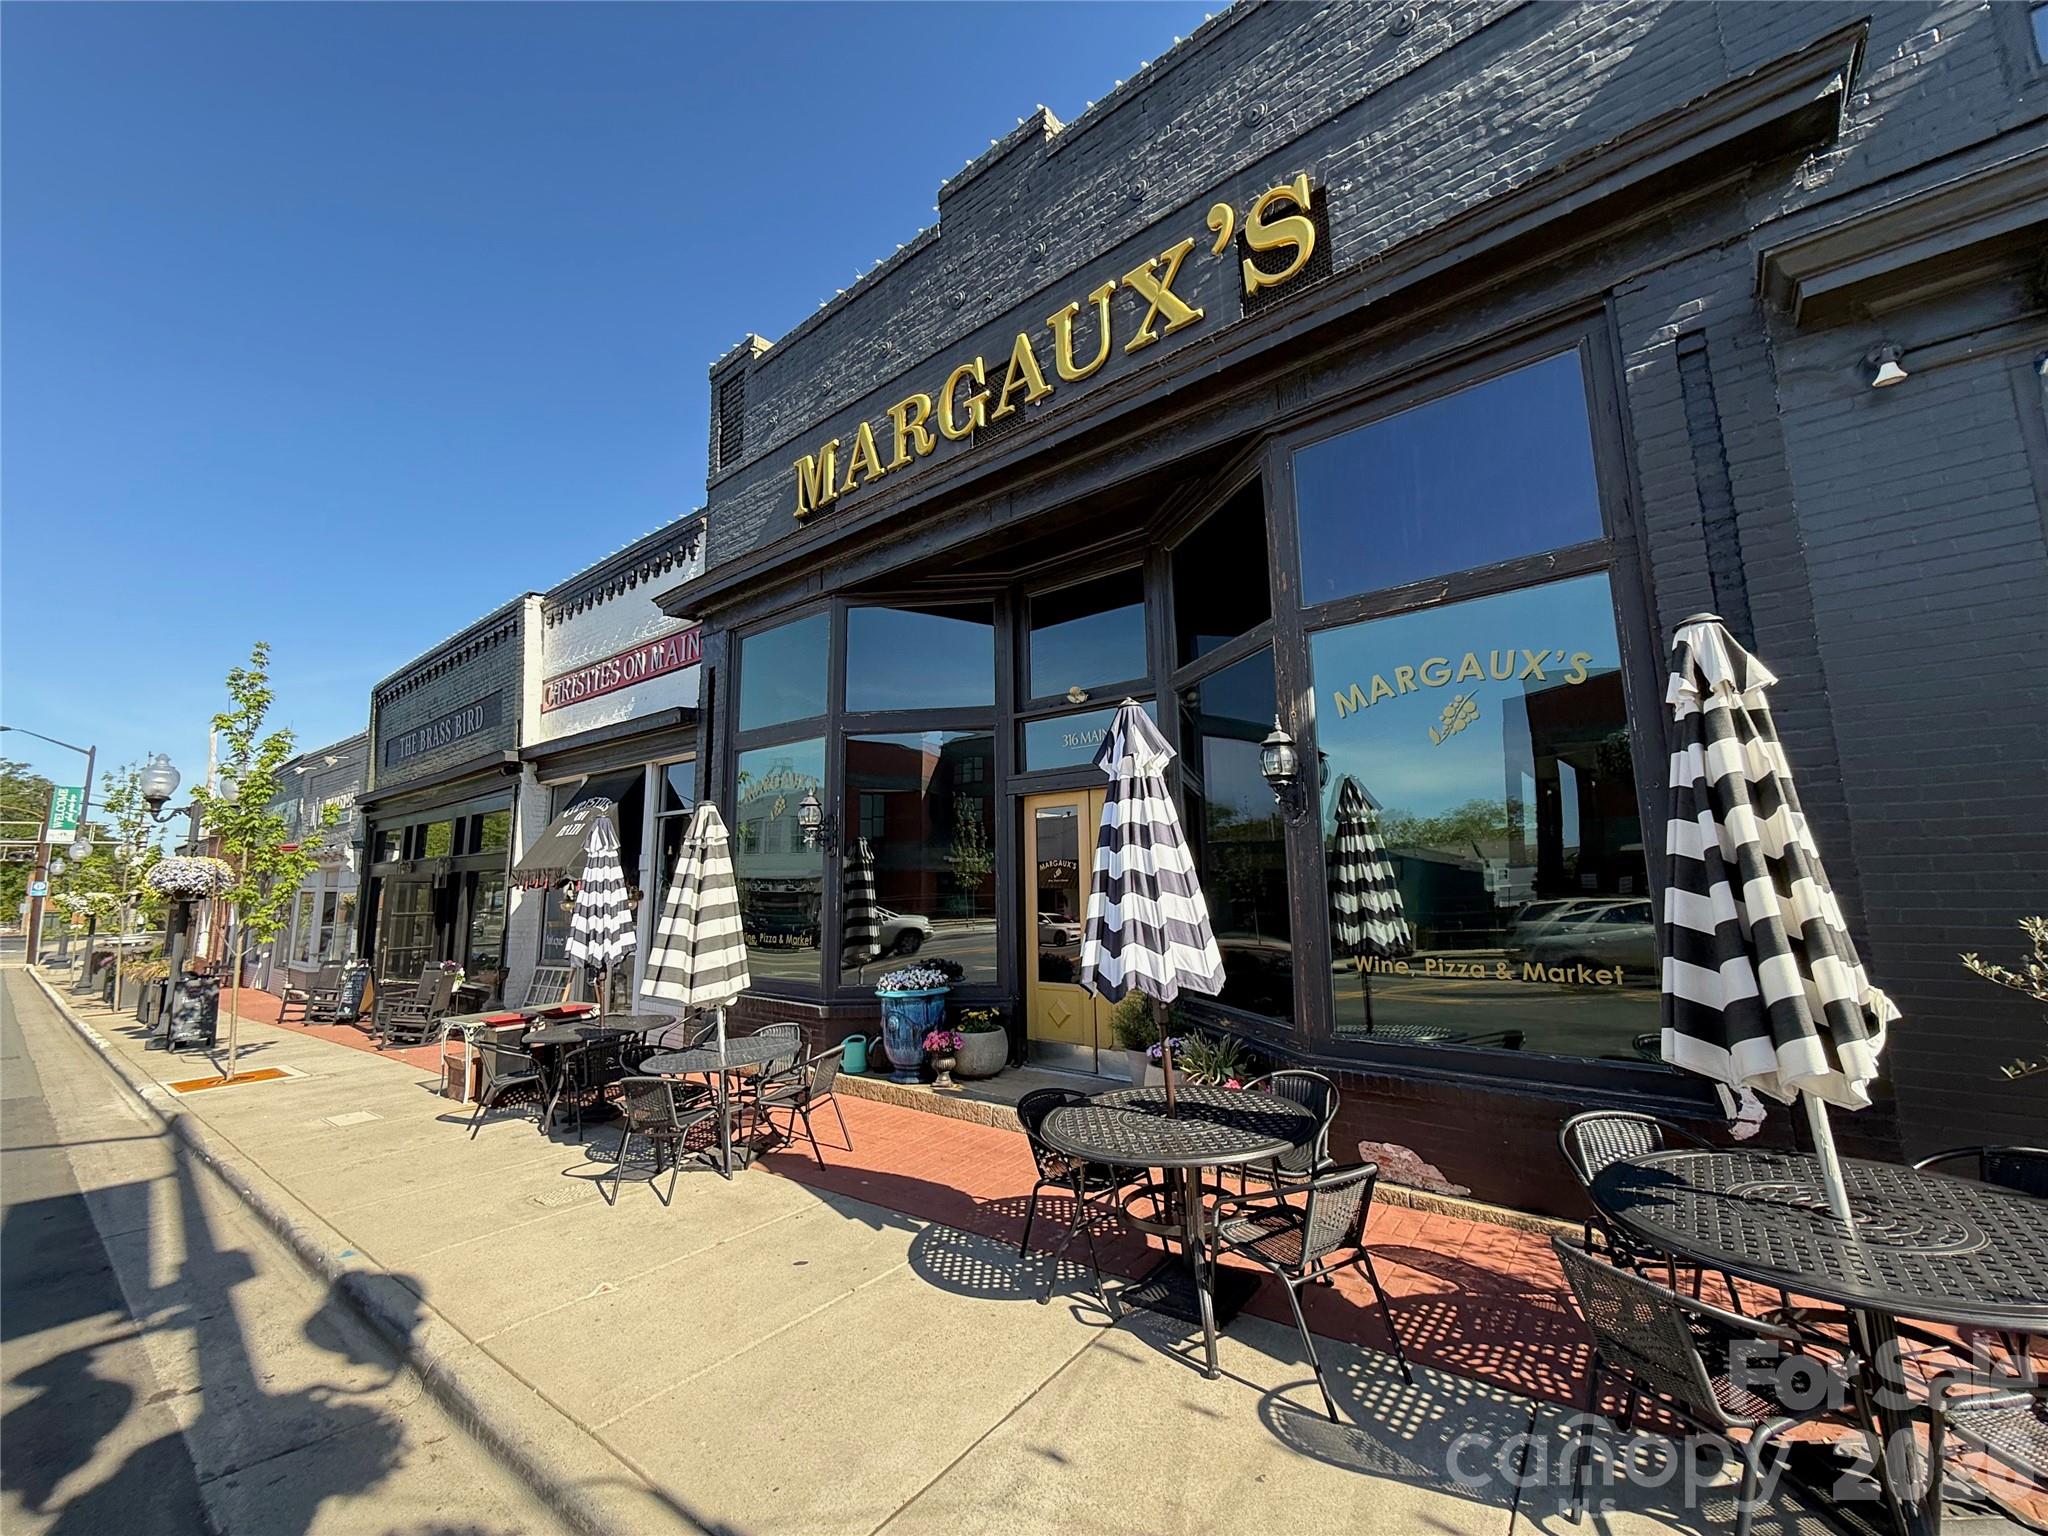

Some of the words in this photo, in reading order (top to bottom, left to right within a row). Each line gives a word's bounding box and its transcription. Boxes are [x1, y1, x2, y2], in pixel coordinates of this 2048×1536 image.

[792, 173, 1317, 519] MARGAUX'S
[544, 656, 620, 707] CHRISTIES
[623, 649, 648, 681] ON
[650, 630, 701, 673] MAIN
[1333, 649, 1593, 719] MARGAUX'S
[399, 732, 417, 758] THE
[420, 719, 452, 752] BRASS
[455, 705, 484, 738] BIRD
[1062, 733, 1079, 748] 316
[52, 788, 69, 829] WELCOME
[759, 932, 777, 944] Pizza
[779, 934, 785, 944] &
[785, 933, 813, 946] Market
[1353, 955, 1417, 977] Wine,
[1424, 958, 1486, 979] Pizza
[1495, 961, 1513, 980] &
[1522, 962, 1624, 985] Market
